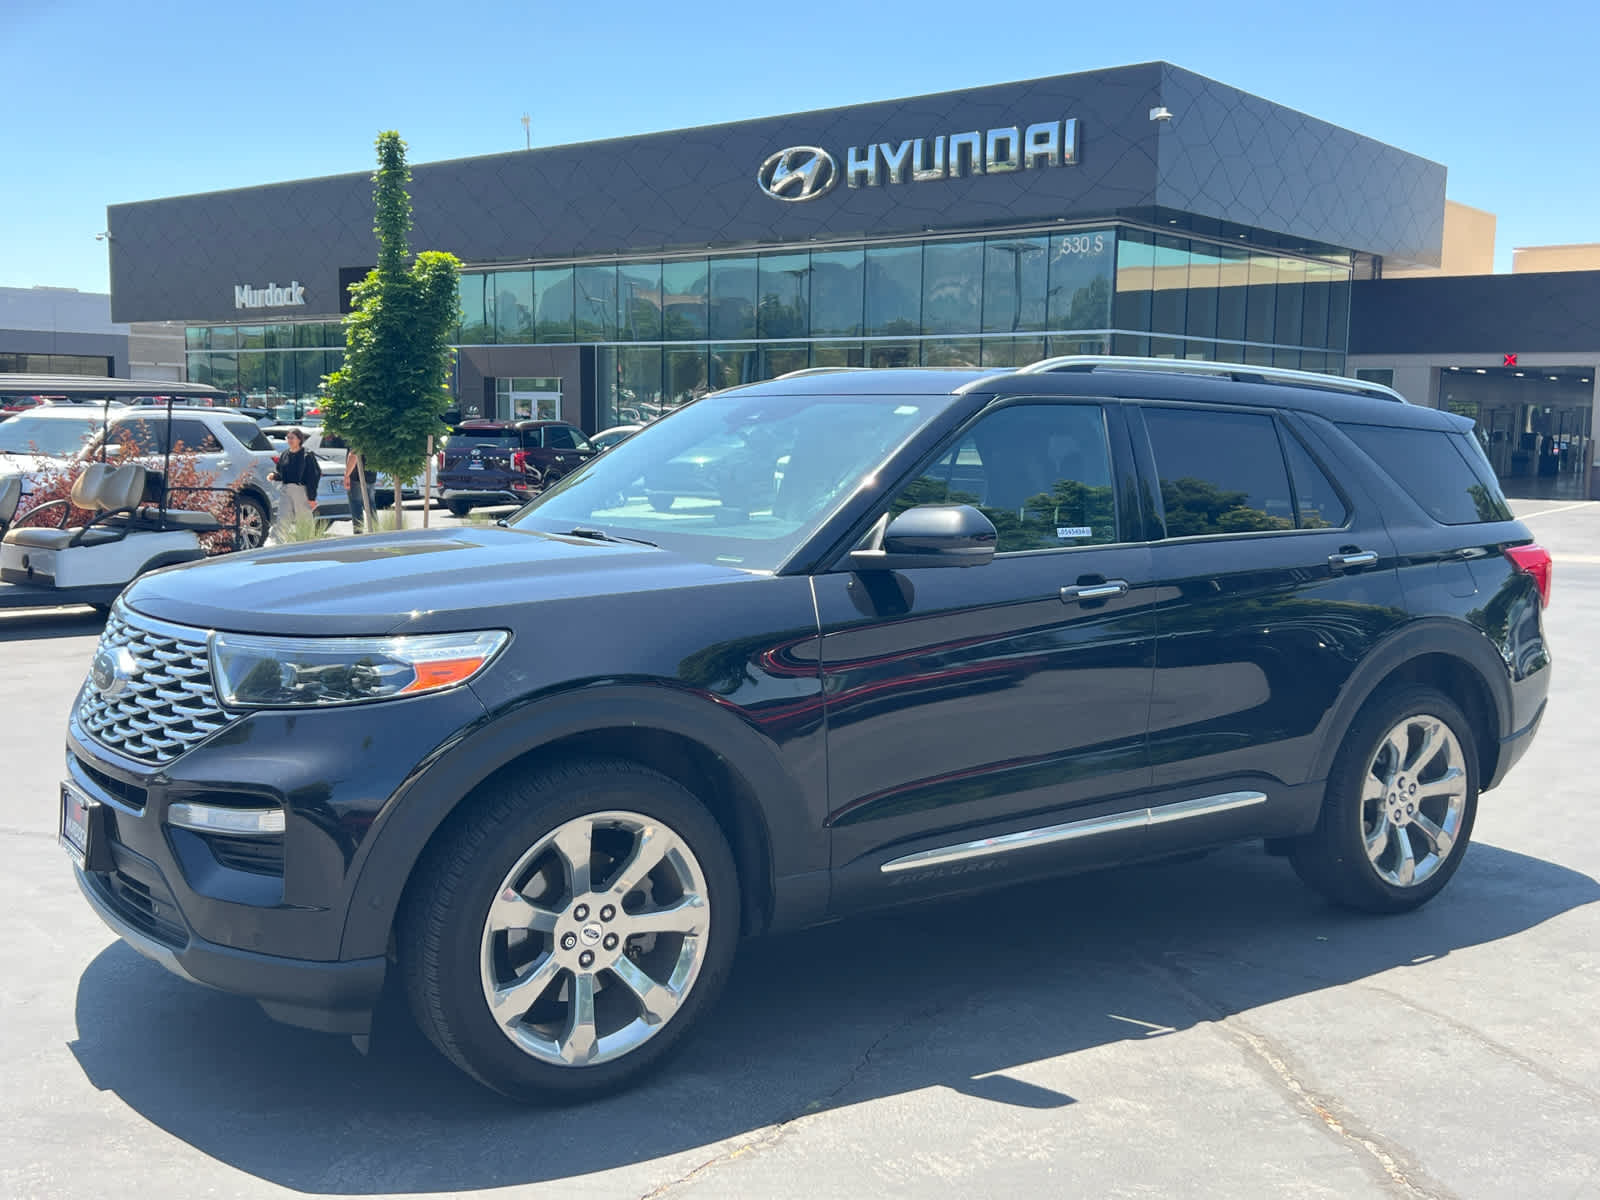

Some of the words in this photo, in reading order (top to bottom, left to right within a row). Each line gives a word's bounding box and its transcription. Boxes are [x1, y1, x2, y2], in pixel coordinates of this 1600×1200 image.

[847, 117, 1080, 189] HYUNDAI
[1062, 236, 1089, 255] 530
[1094, 234, 1104, 252] S
[234, 280, 305, 309] Murdock
